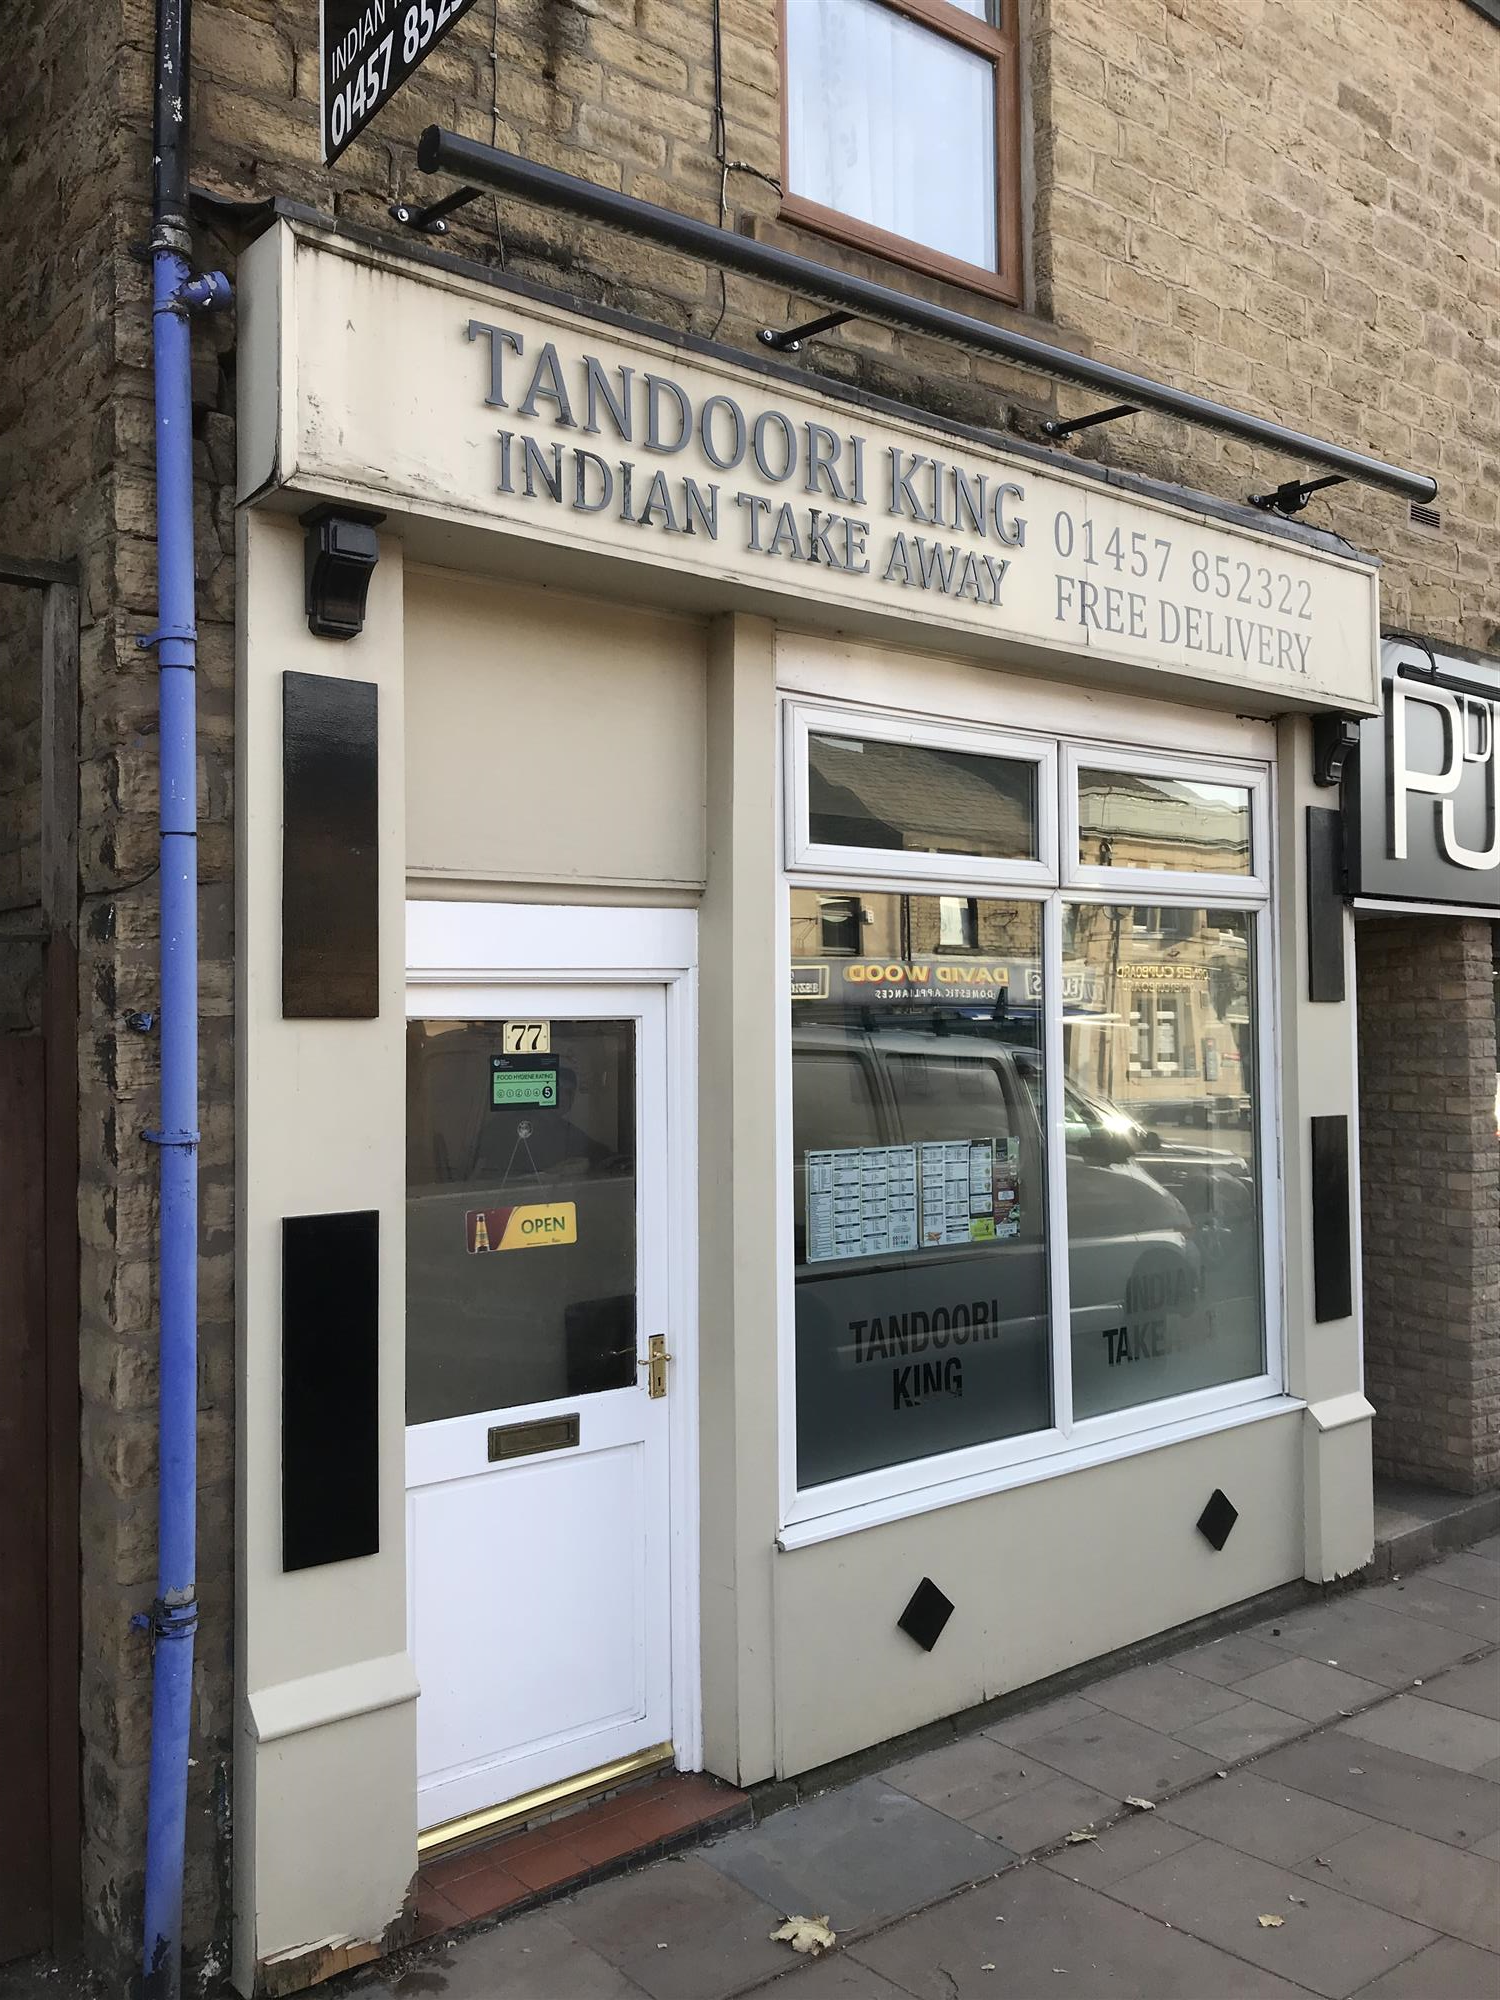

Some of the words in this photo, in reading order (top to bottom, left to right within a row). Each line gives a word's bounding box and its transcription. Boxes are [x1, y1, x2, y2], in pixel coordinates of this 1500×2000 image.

[331, 0, 386, 84] INDIAN
[330, 30, 394, 147] 01457
[467, 318, 867, 505] TANDOORI
[887, 445, 1028, 548] KING
[496, 428, 721, 541] INDIAN
[736, 490, 871, 574] TAKE
[883, 530, 1012, 606] AWAY
[1054, 510, 1172, 583] 01457
[1191, 549, 1313, 621] 852322
[1054, 573, 1148, 640] FREE
[1159, 598, 1312, 675] DELIVERY
[511, 1024, 542, 1051] 77
[521, 1215, 566, 1235] OPEN
[849, 1299, 999, 1364] TANDOORI
[1103, 1319, 1165, 1367] TAKE
[892, 1357, 963, 1410] KING
